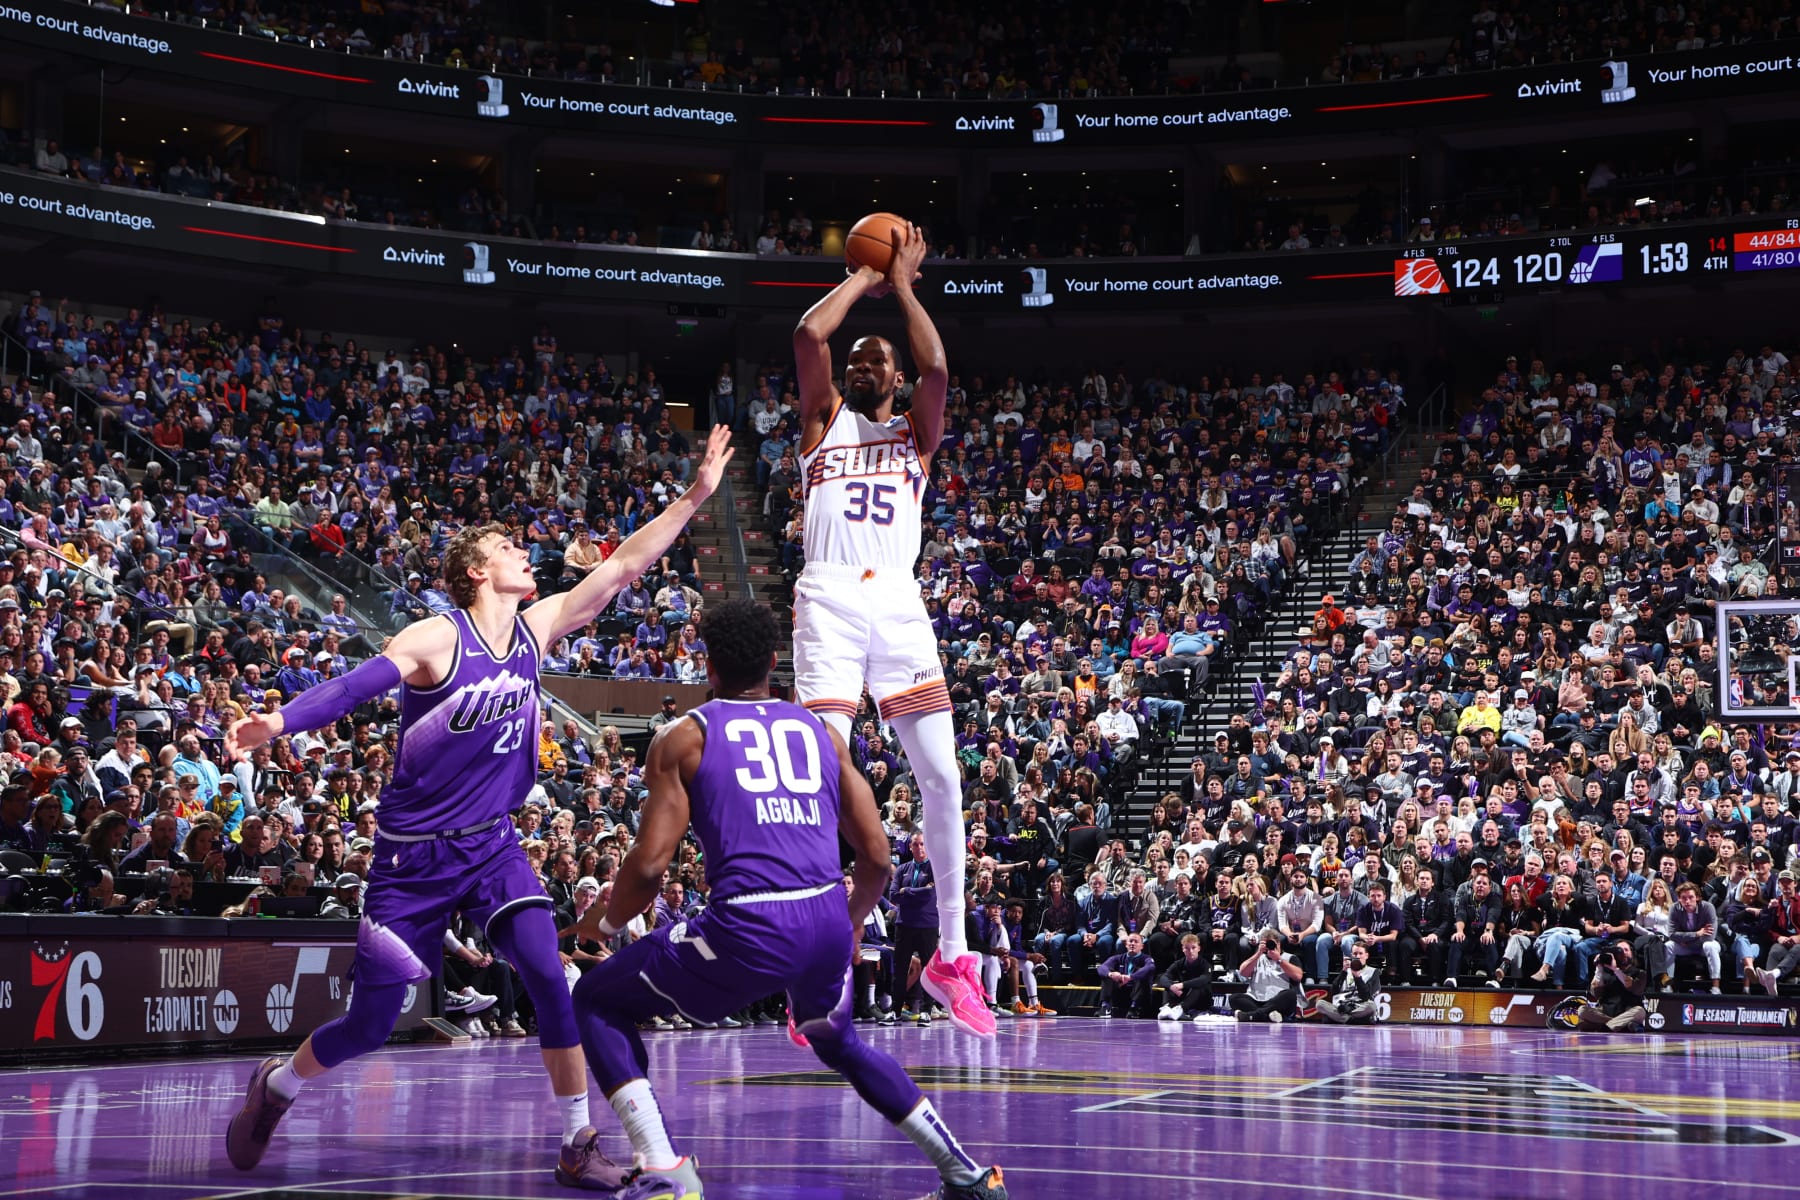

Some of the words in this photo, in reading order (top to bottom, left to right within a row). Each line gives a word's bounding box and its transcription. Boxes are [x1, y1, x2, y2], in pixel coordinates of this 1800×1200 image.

[0, 5, 32, 23] ome
[36, 14, 79, 35] court
[82, 25, 172, 54] advantage.
[1648, 69, 1687, 84] Your
[1691, 64, 1741, 80] home
[1745, 56, 1793, 74] court
[520, 92, 556, 109] Your
[559, 96, 604, 113] home
[608, 103, 650, 117] court
[653, 104, 737, 125] advantage.
[1075, 113, 1111, 127] Your
[1114, 112, 1159, 127] home
[1162, 111, 1204, 125] court
[1207, 107, 1292, 123] advantage.
[18, 195, 62, 214] court
[65, 203, 155, 230] advantage.
[1786, 219, 1799, 229] FG
[1437, 247, 1443, 256] 2
[1445, 246, 1460, 255] TOL
[1550, 238, 1556, 247] 2
[1557, 237, 1572, 246] TOL
[1592, 235, 1598, 243] 4
[1600, 233, 1615, 242] FLS
[1708, 236, 1727, 252] 14
[1749, 233, 1795, 248] 44/84
[1403, 250, 1409, 258] 4
[1411, 249, 1425, 258] FLS
[1513, 252, 1562, 284] 120
[1640, 241, 1688, 275] 1:53
[1703, 256, 1728, 270] 4TH
[1752, 251, 1795, 267] 41/80
[507, 258, 542, 275] Your
[546, 262, 591, 279] home
[594, 268, 637, 282] court
[640, 269, 725, 289] advantage.
[1064, 278, 1100, 292] Your
[1104, 277, 1148, 291] home
[1152, 277, 1194, 290] court
[1197, 274, 1282, 289] advantage.
[1451, 257, 1500, 288] 124
[822, 442, 907, 480] SUNS
[843, 481, 897, 526] 35
[913, 664, 941, 684] PHOE
[447, 679, 535, 735] UTAH
[492, 717, 526, 754] 23
[724, 718, 822, 794] 30
[755, 797, 822, 826] AGBAJI
[159, 948, 221, 989] TUESDAY
[30, 950, 104, 1041] 76
[1419, 992, 1455, 1007] TUESDAY
[143, 996, 192, 1033] 7:30PM
[194, 995, 207, 1031] ET
[1694, 1008, 1736, 1023] IN-SEASON
[1736, 1006, 1789, 1028] TOURNAMENT
